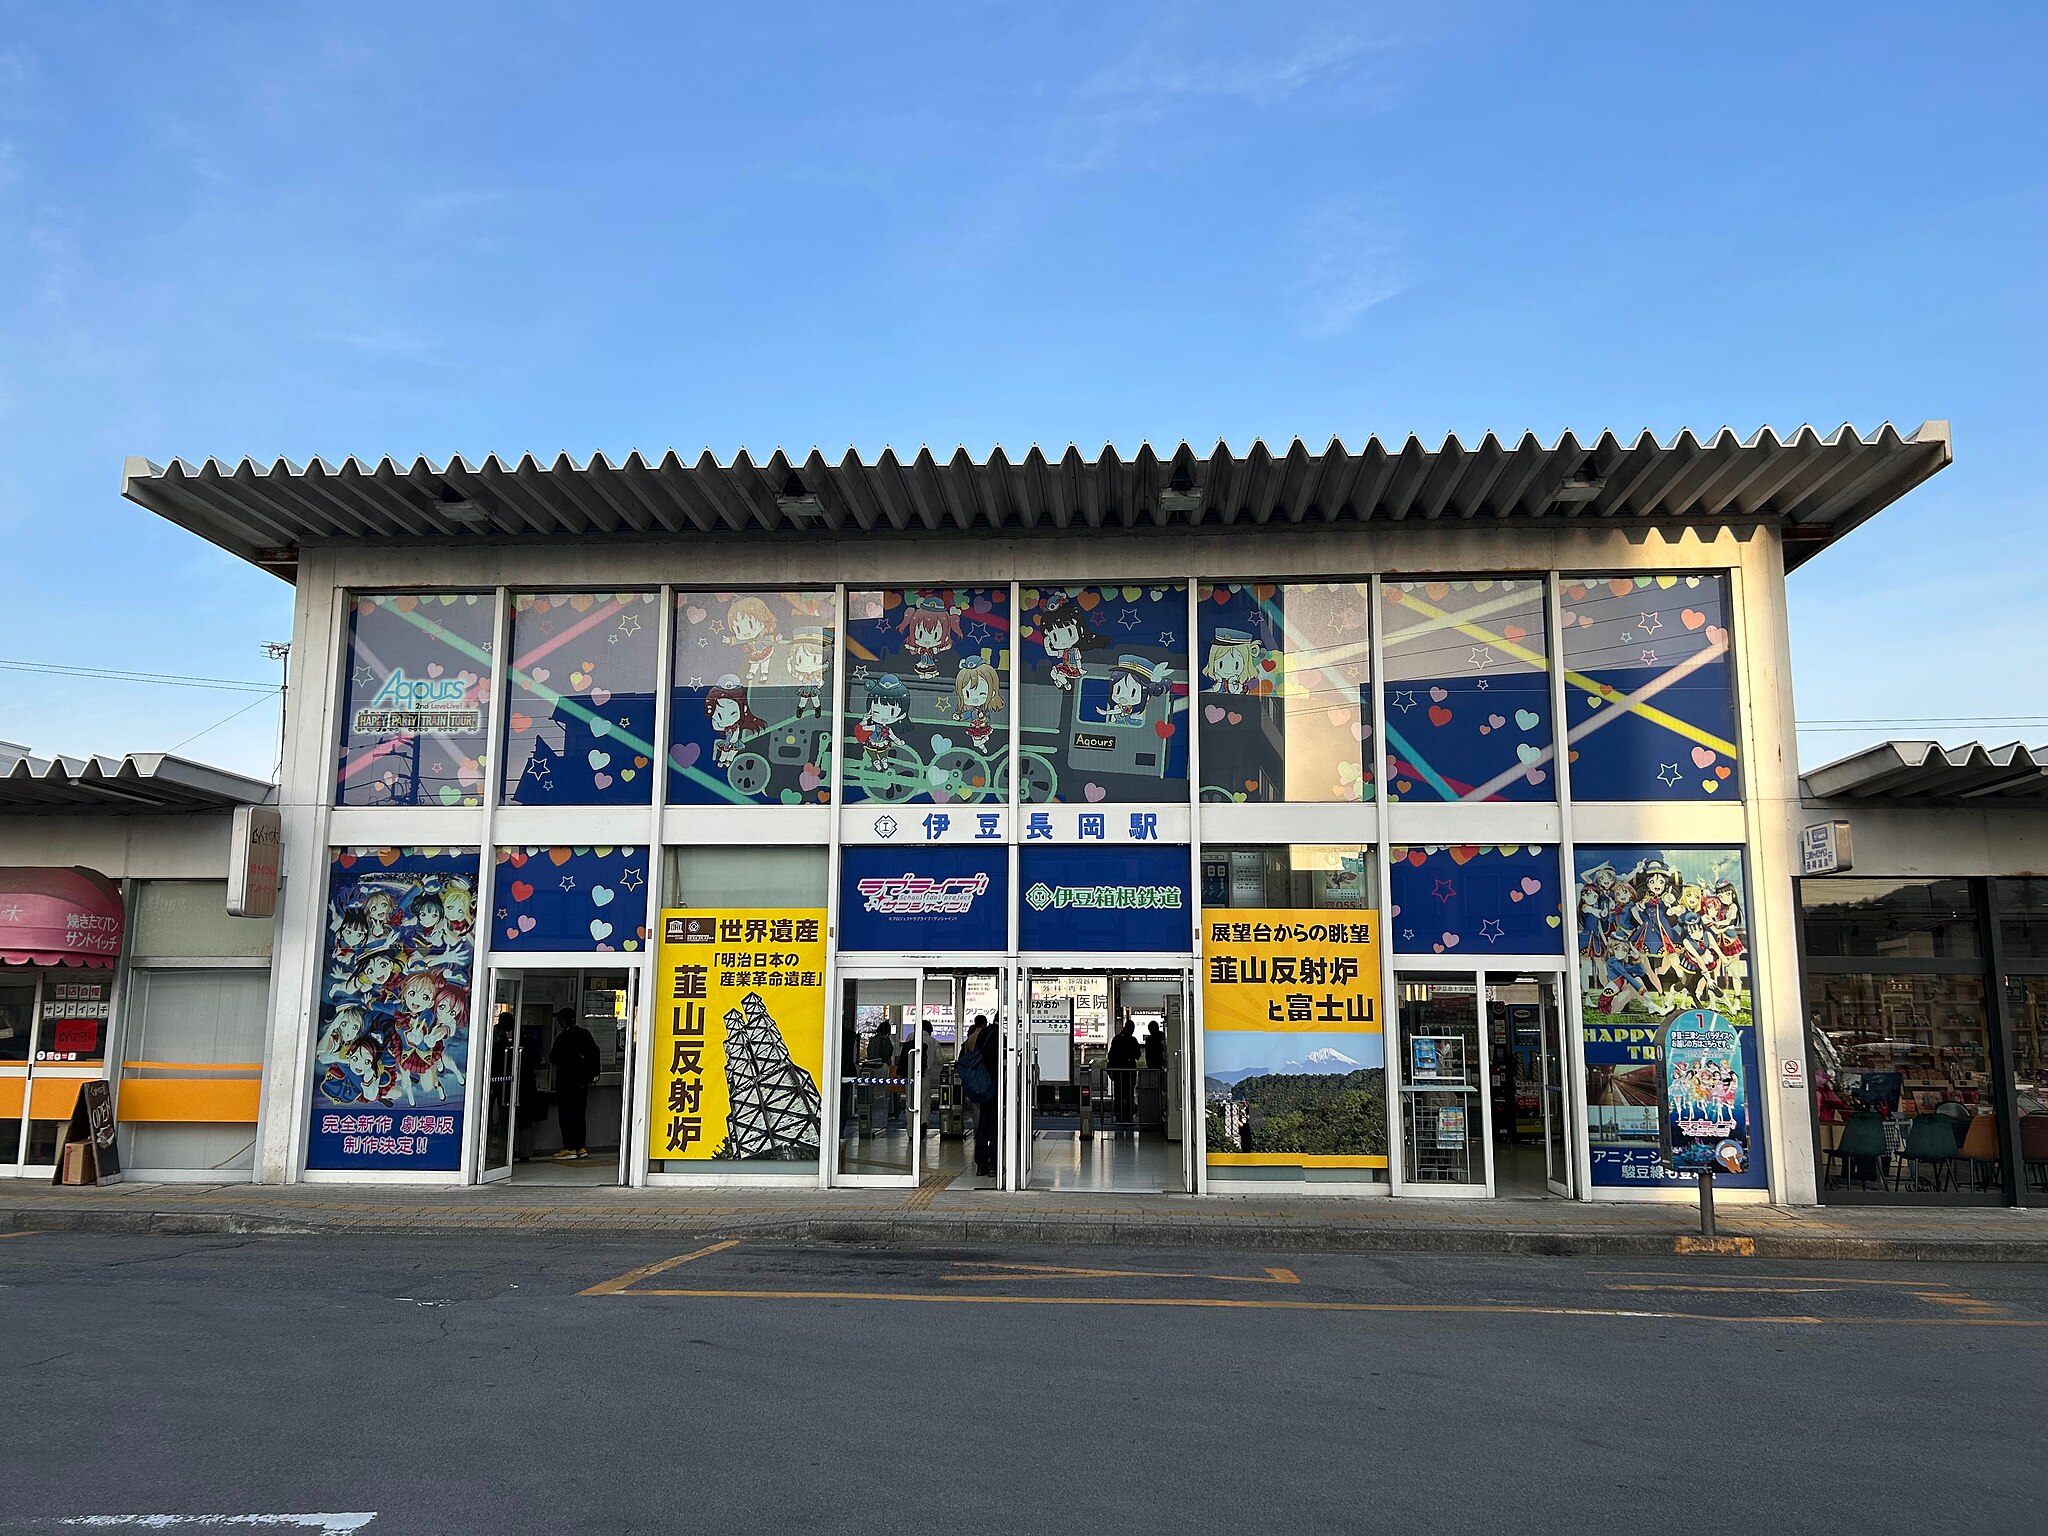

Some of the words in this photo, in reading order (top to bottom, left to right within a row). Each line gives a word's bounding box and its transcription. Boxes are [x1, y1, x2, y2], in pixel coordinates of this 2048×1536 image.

[371, 669, 466, 709] Aqours
[415, 702, 429, 710] 2nd
[359, 714, 387, 728] HAPPY
[391, 714, 418, 728] PARTY
[420, 714, 447, 728] TRAIN
[450, 714, 473, 728] TOUR
[1075, 733, 1114, 748] Aqours
[922, 812, 1158, 840] 伊豆長岡駅
[1053, 886, 1182, 909] 伊豆箱根鉄道
[66, 912, 120, 932] 焼きたてパン
[719, 919, 819, 943] 世界遺産
[65, 931, 117, 950] サンドイッチ
[1211, 923, 1370, 943] 展望台からの眺望
[1210, 956, 1358, 985] 韮山反射炉
[44, 1003, 108, 1015] サンドイッチ
[965, 1008, 997, 1016] クリニック
[1268, 993, 1374, 1022] と富士山
[1696, 1013, 1704, 1028] 1
[1584, 1029, 1657, 1043] HAPPY
[665, 964, 708, 1153] 韮山反射炉
[92, 1097, 111, 1129] OPEN
[321, 1115, 393, 1134] 完全新作
[400, 1115, 454, 1134] 劇場版
[343, 1136, 428, 1155] 制作決定!!
[1593, 1151, 1671, 1164] アニメーシ
